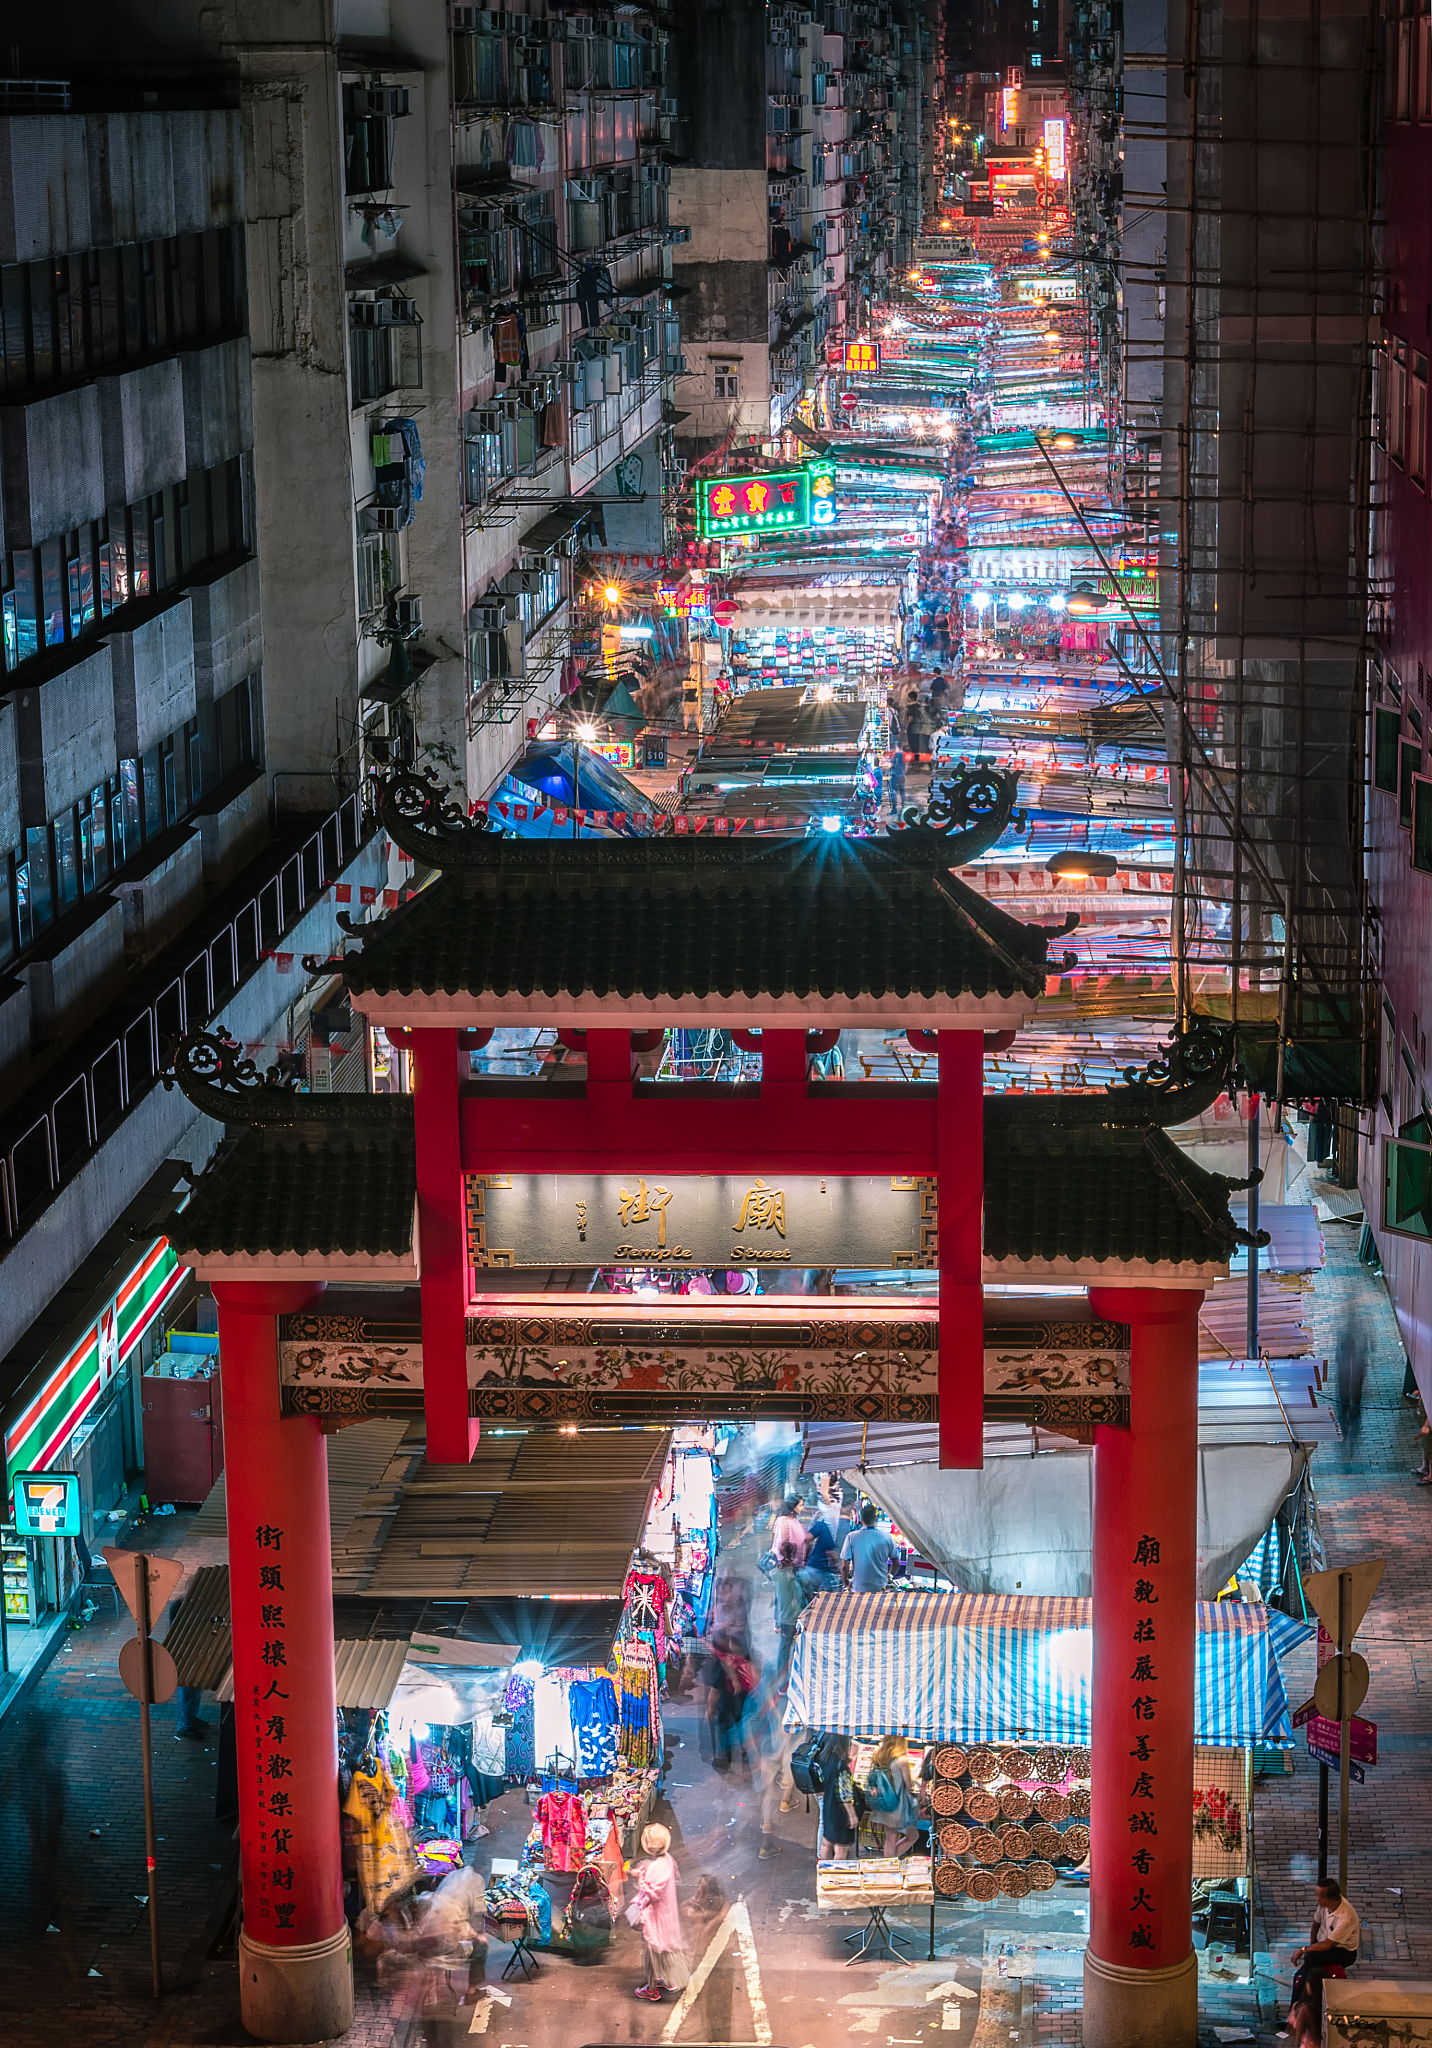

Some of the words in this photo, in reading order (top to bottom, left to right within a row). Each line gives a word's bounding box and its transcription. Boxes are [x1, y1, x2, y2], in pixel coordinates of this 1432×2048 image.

[1134, 579, 1155, 595] KITCHEN
[647, 751, 664, 760] $10
[614, 1244, 692, 1262] Temple
[730, 1245, 792, 1260] Street
[28, 1485, 64, 1532] 7
